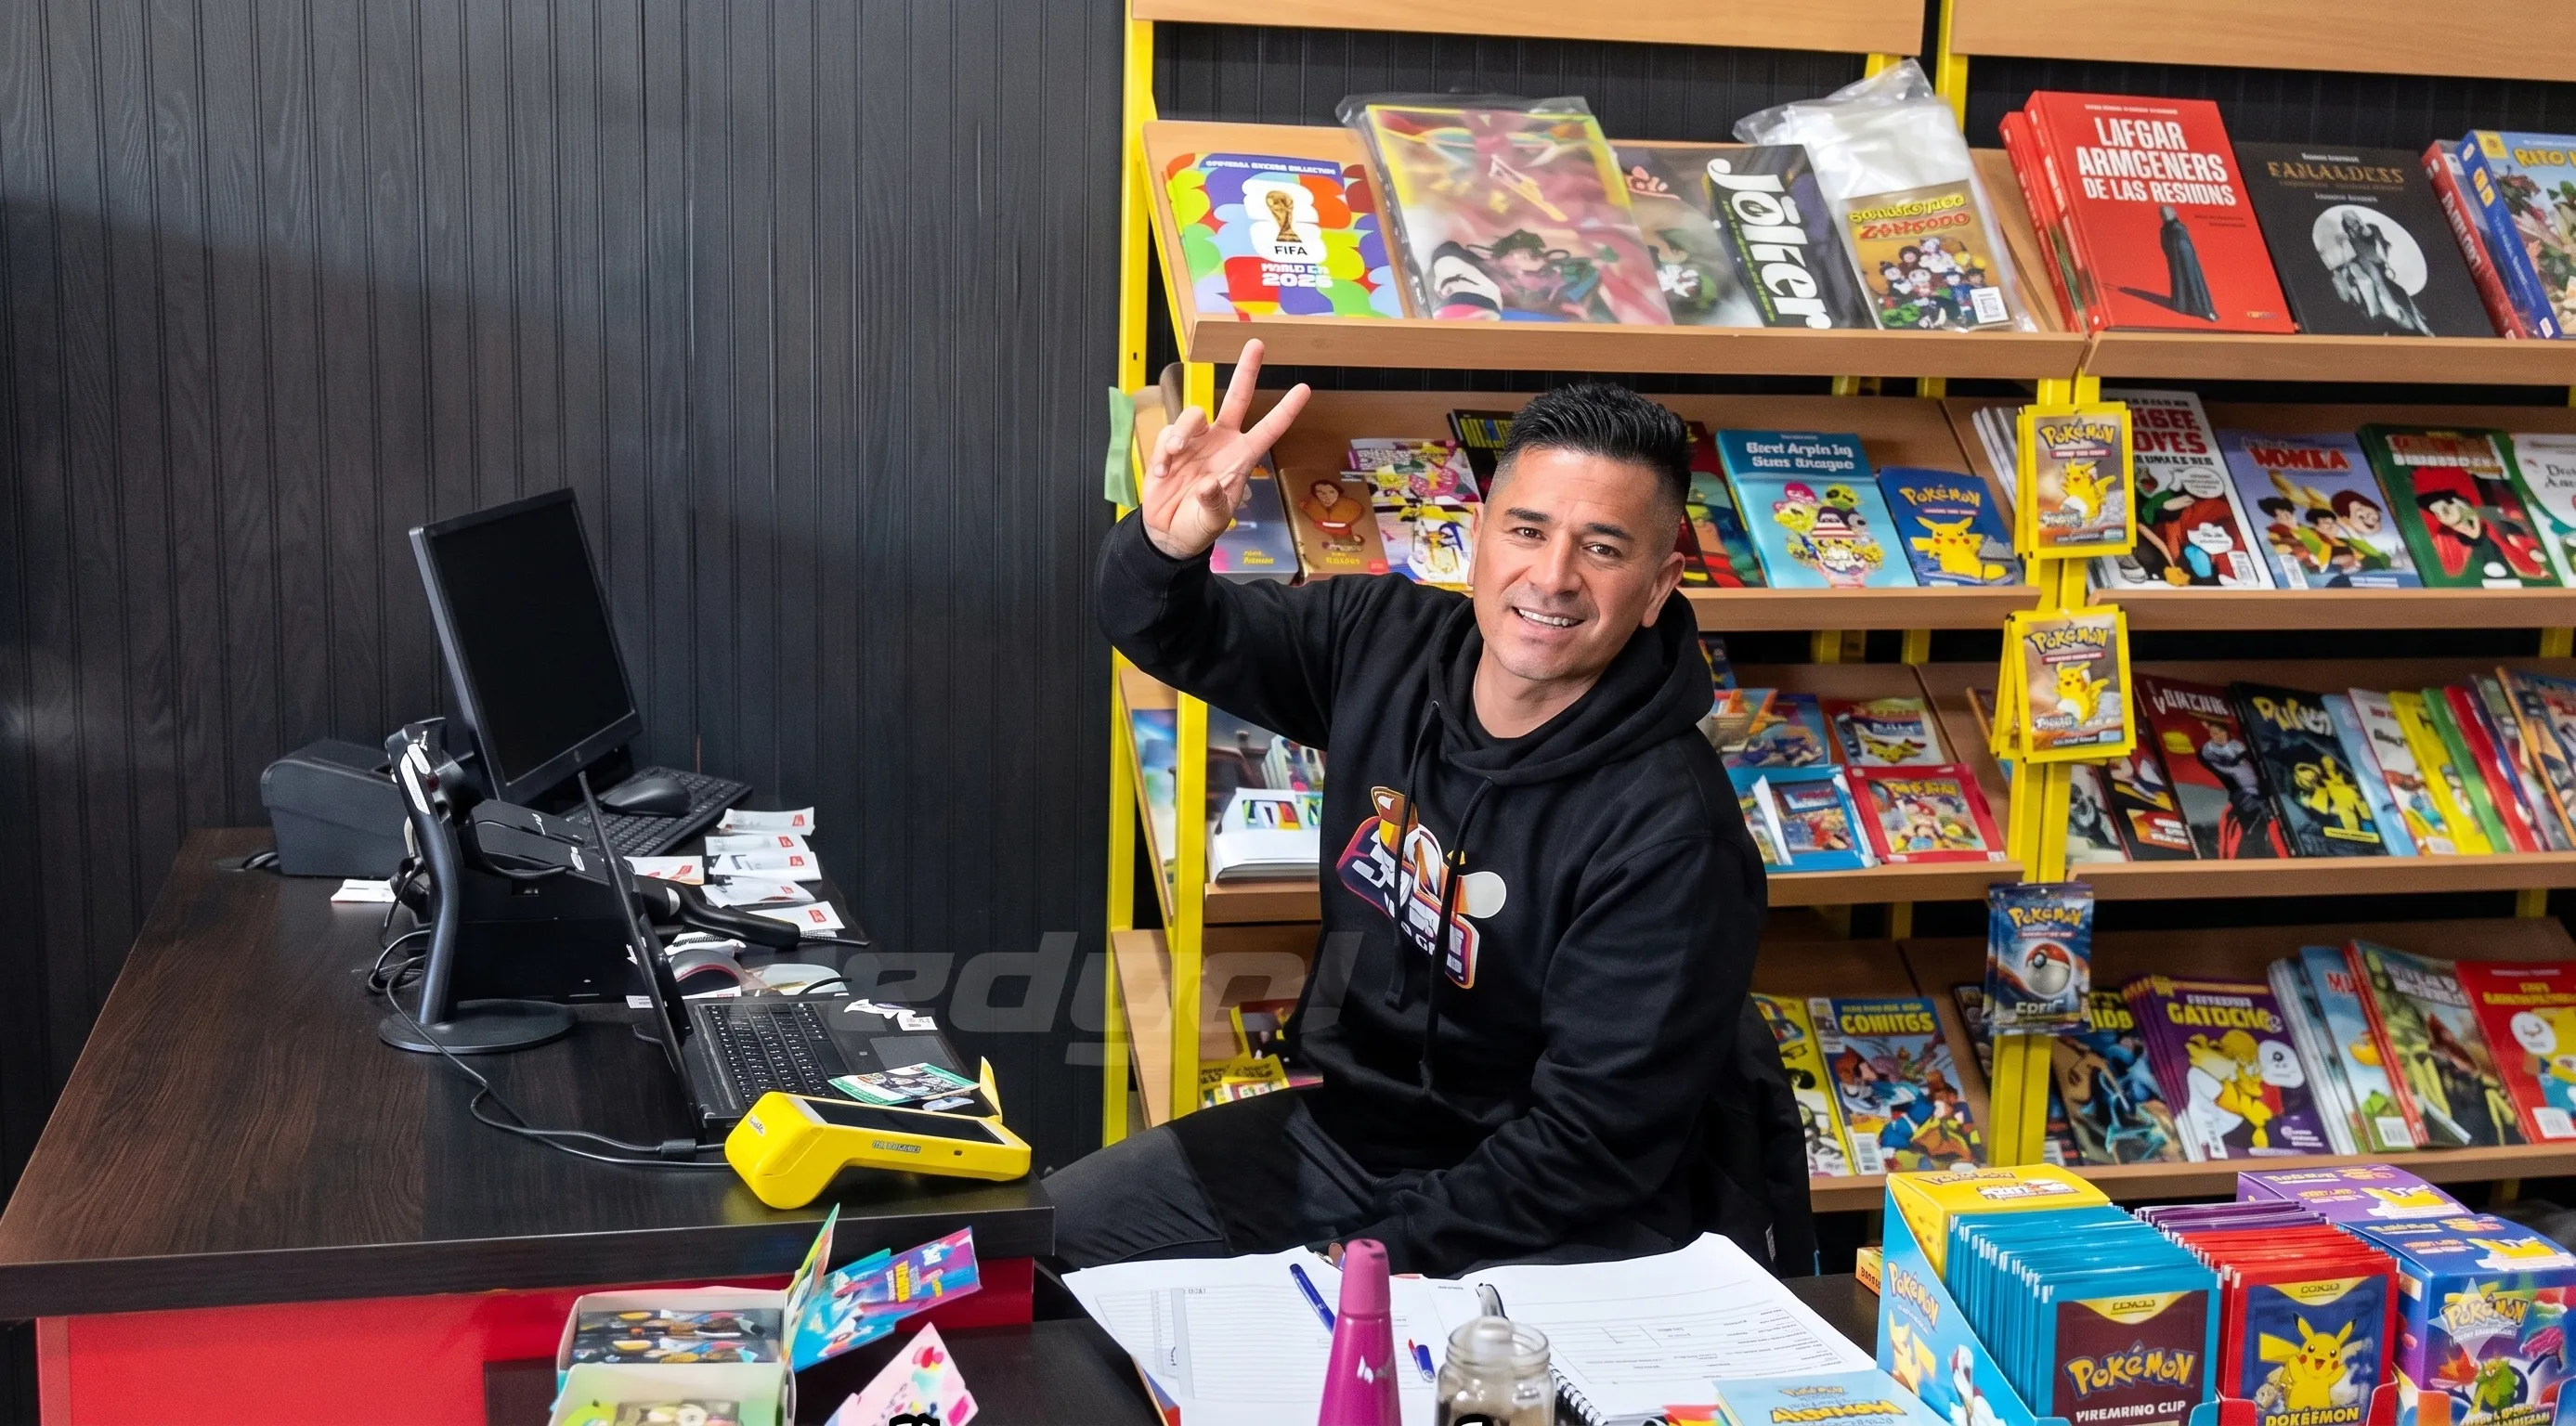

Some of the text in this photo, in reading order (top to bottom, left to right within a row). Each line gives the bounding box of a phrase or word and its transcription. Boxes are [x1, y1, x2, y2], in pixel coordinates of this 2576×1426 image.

[2082, 177, 2110, 200] DE
[2110, 179, 2149, 201] LAS
[1274, 245, 1308, 256] FIFA
